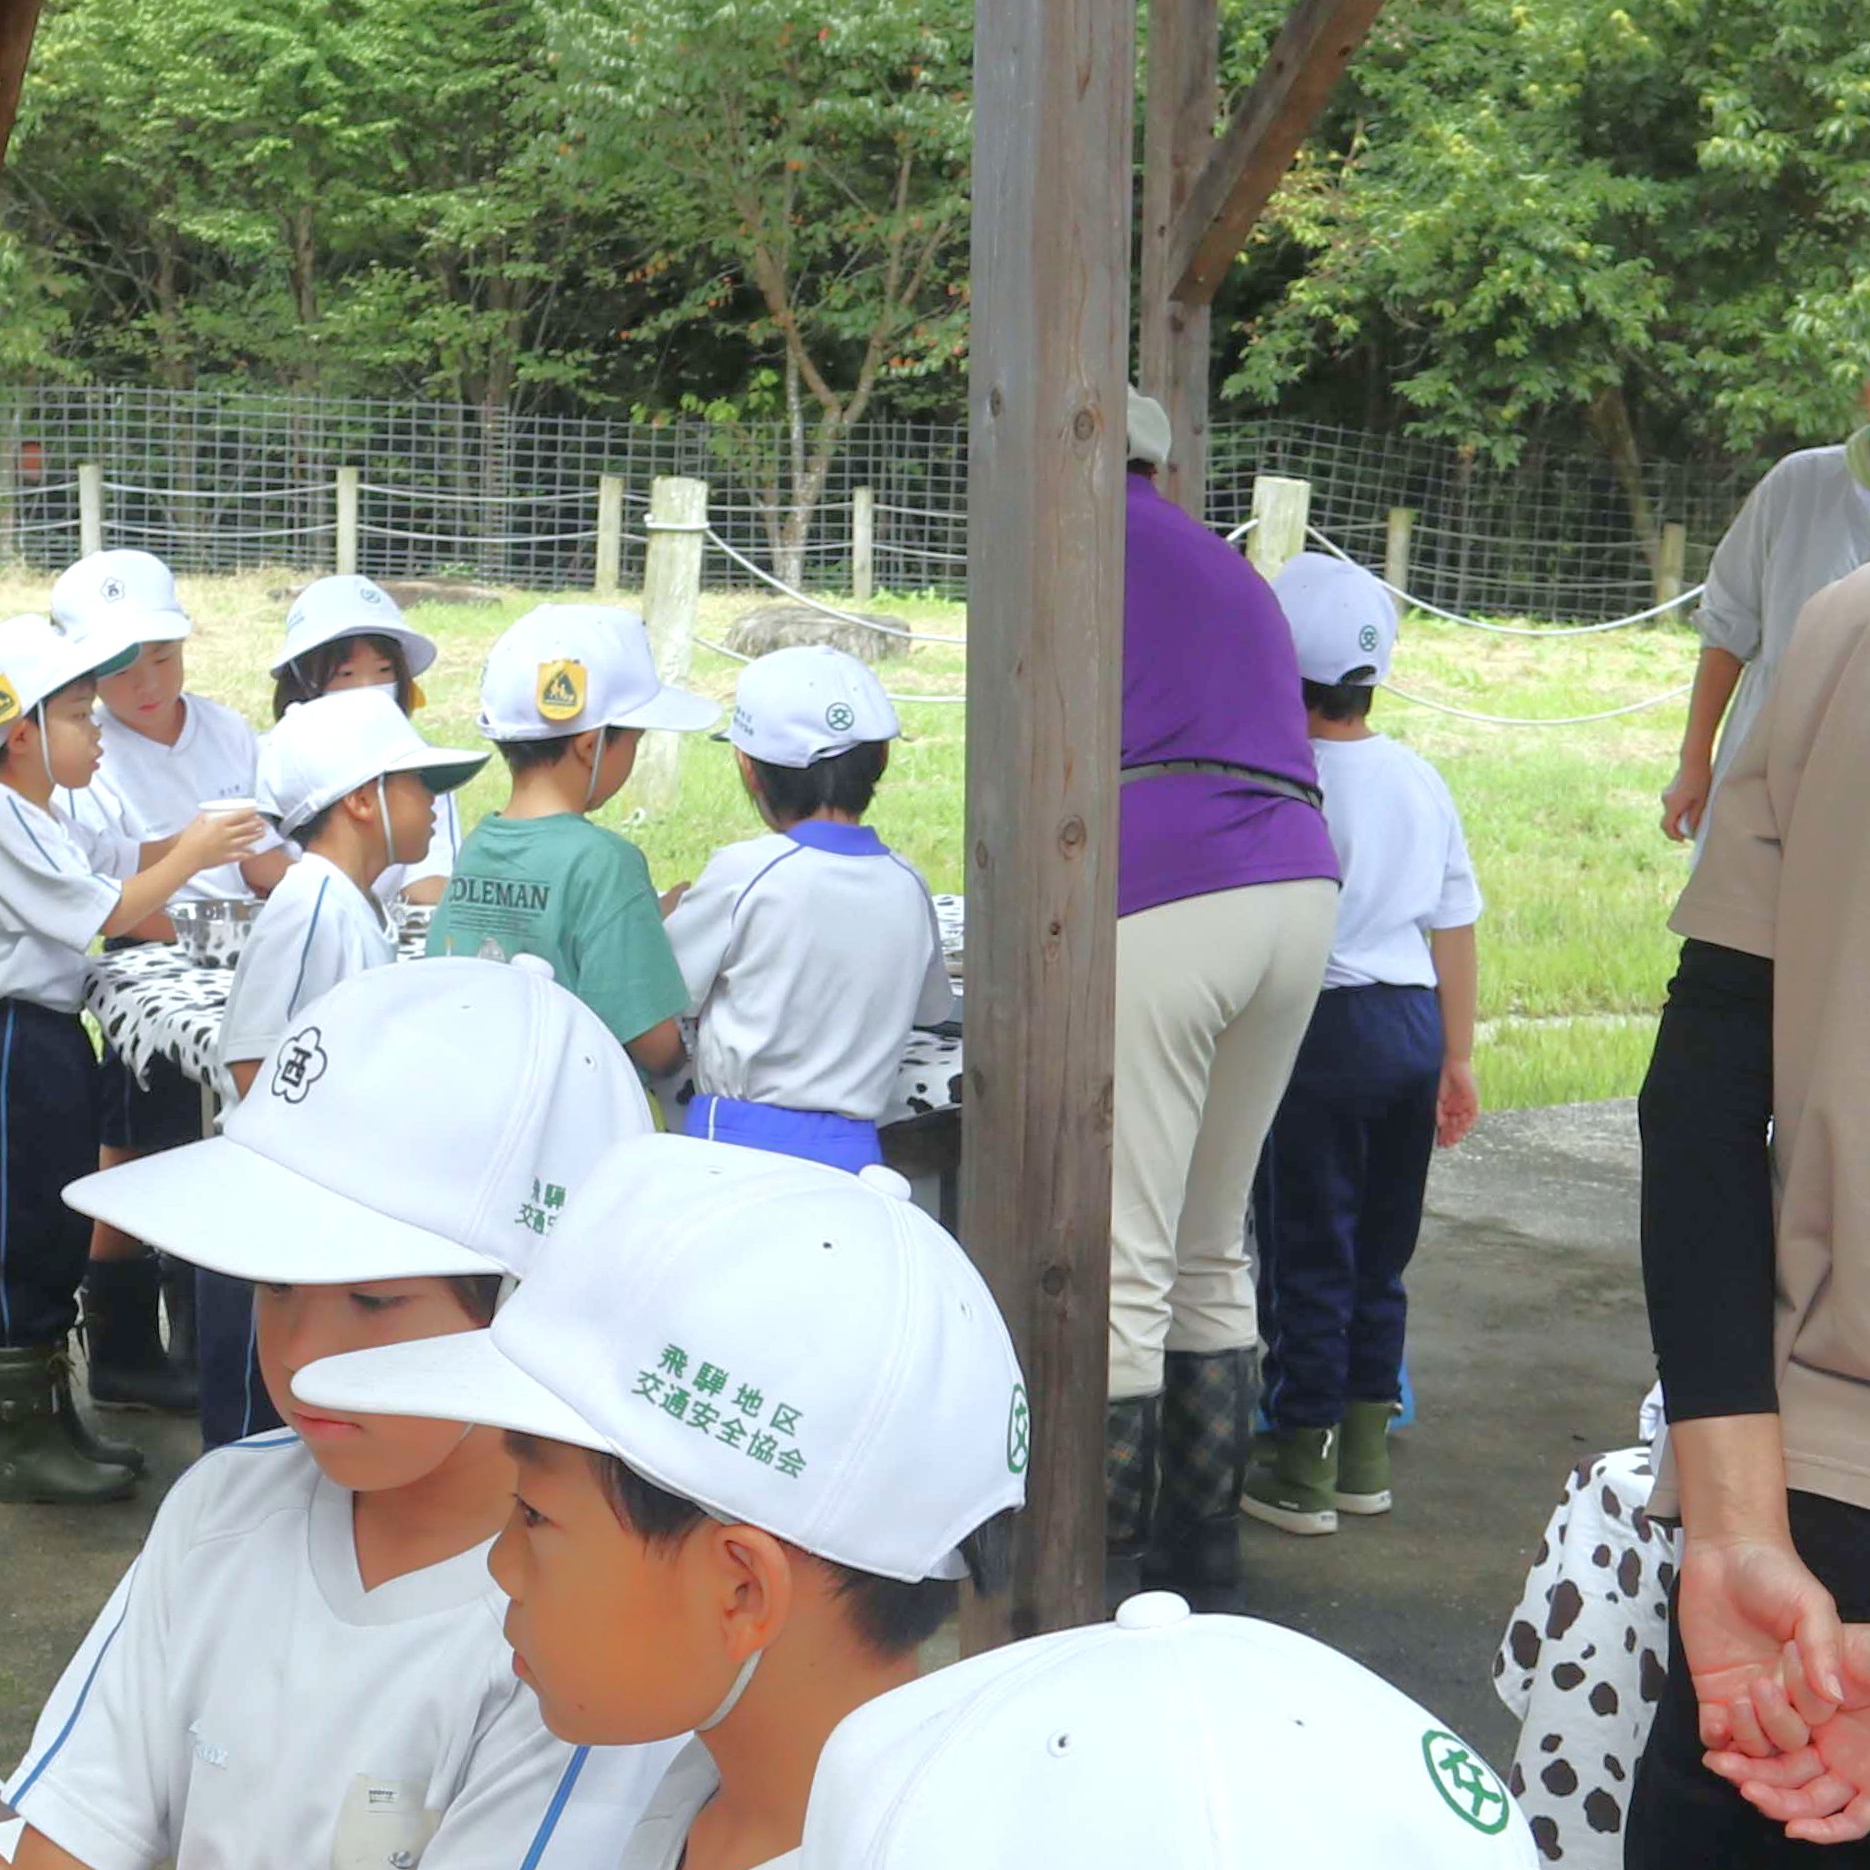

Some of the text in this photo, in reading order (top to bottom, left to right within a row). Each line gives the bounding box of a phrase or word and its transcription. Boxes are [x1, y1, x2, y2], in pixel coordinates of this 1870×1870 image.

[513, 1202, 559, 1237] 交通
[630, 1369, 808, 1479] 交通安全協会
[656, 1342, 804, 1438] 飛騨地区
